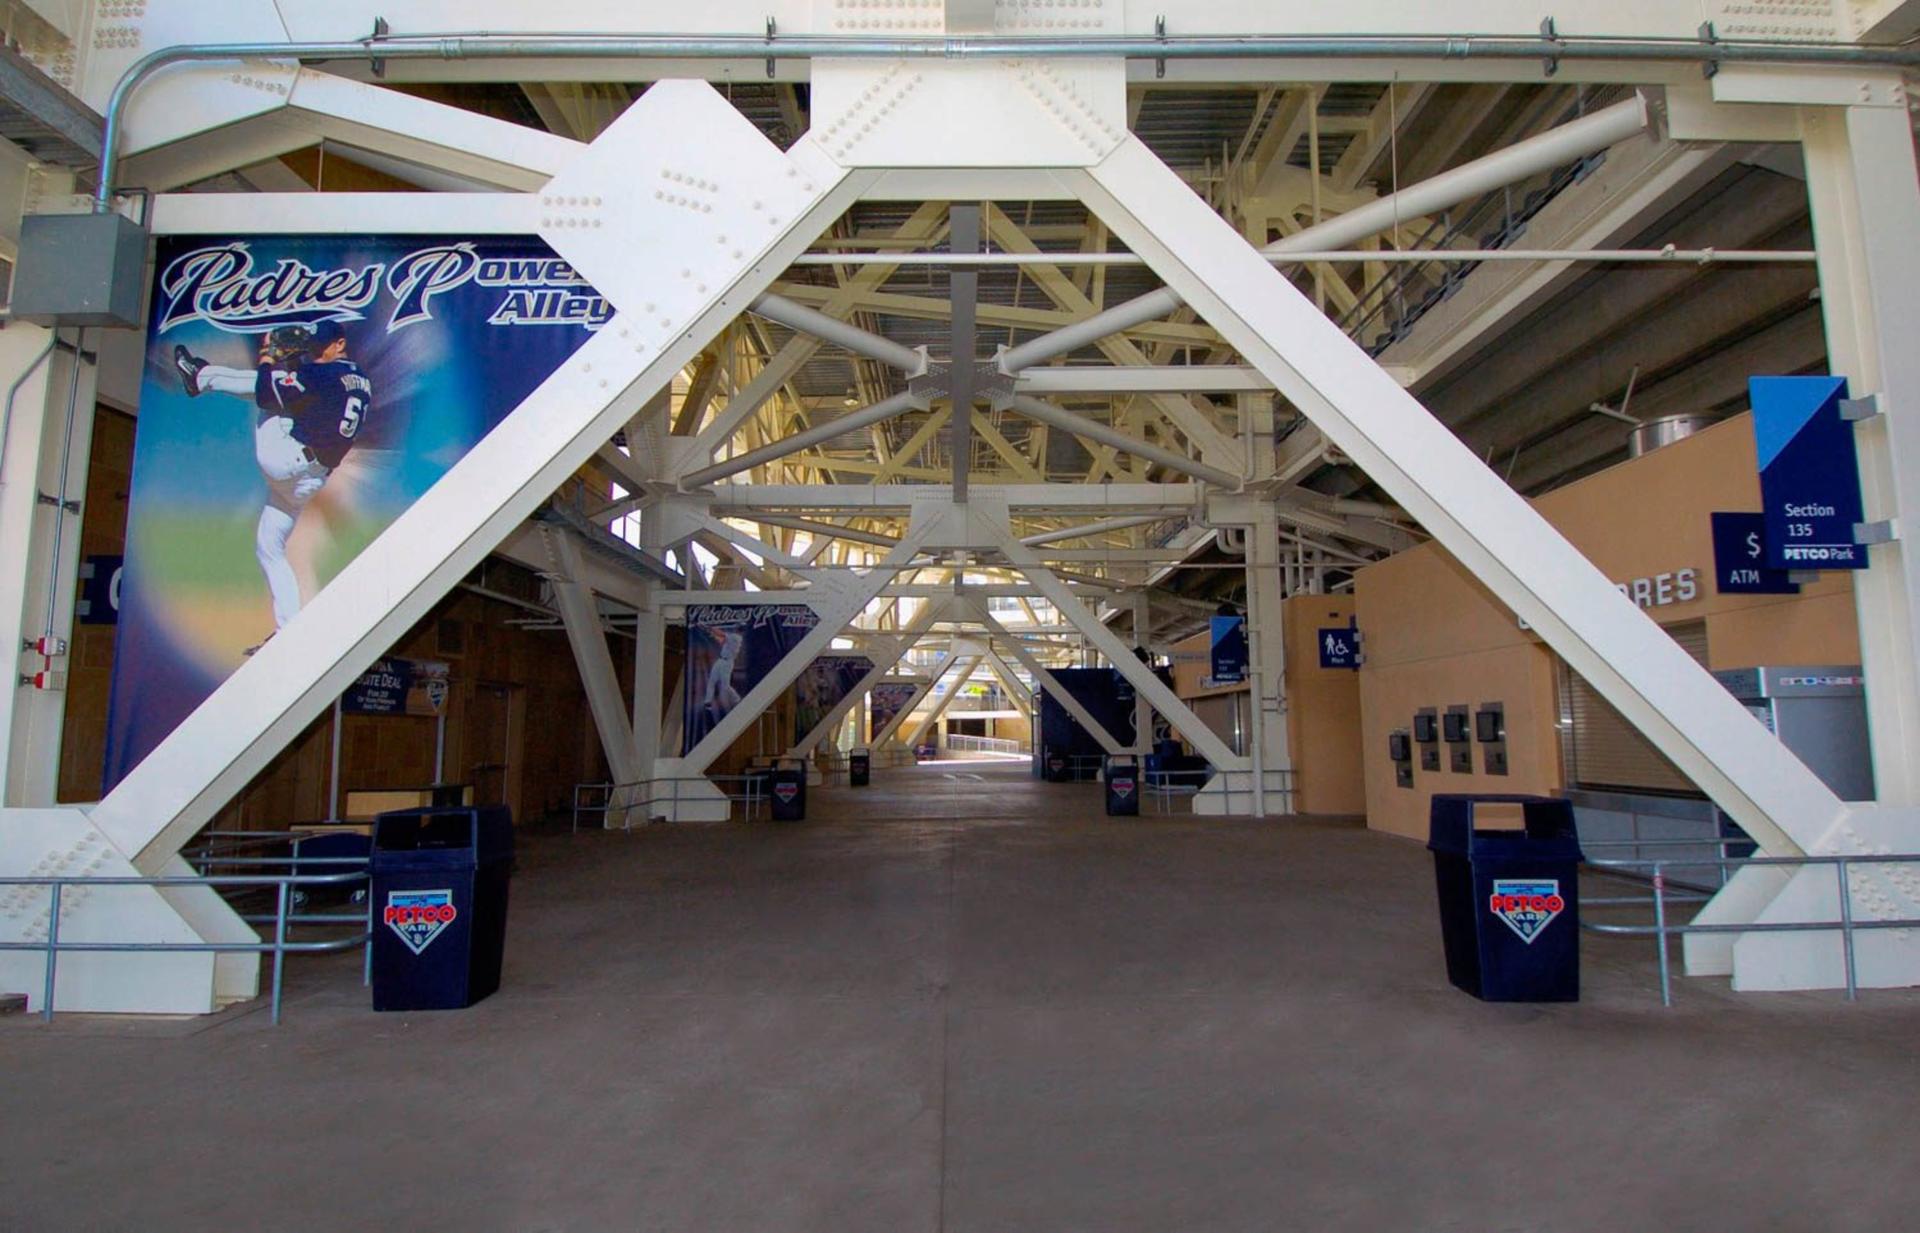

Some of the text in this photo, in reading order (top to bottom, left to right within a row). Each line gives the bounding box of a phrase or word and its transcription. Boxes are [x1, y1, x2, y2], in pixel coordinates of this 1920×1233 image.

[160, 242, 386, 334] Padres
[486, 289, 612, 331] Alley
[1784, 503, 1835, 517] Section
[1788, 523, 1813, 537] 135
[1783, 548, 1854, 560] PETCO Park
[1730, 570, 1760, 584] ATM
[1490, 894, 1564, 912] PETCO
[384, 904, 456, 925] PETCO
